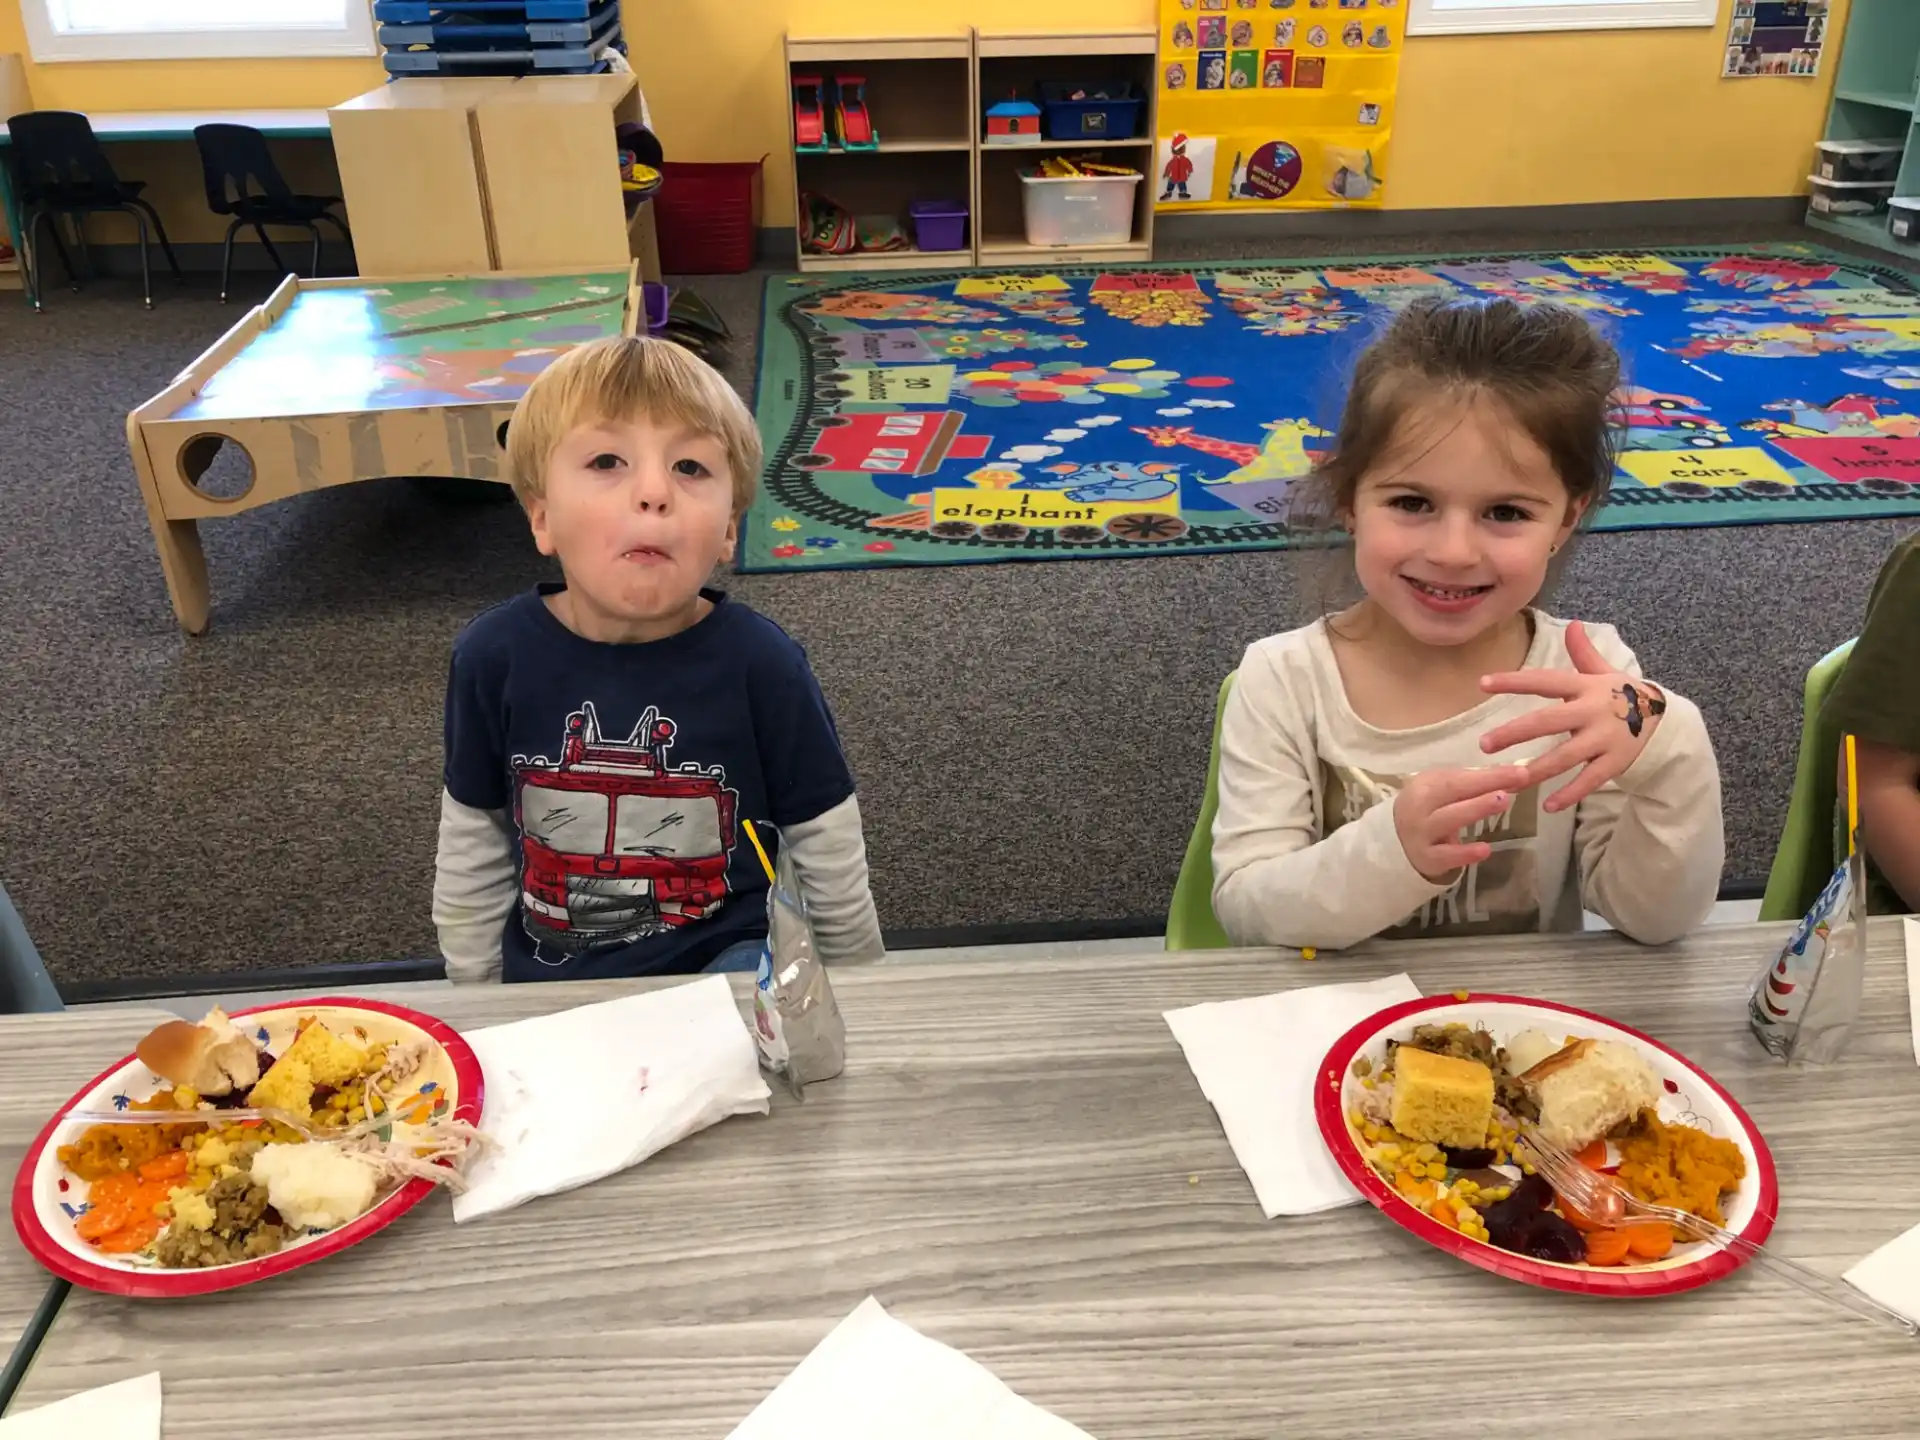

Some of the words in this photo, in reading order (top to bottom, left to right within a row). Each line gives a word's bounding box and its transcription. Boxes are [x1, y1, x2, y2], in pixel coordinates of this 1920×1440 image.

[984, 279, 1035, 287] hats
[867, 369, 897, 401] balloons
[904, 377, 932, 390] 20
[1861, 445, 1889, 457] 5
[1678, 455, 1704, 465] 4
[1670, 467, 1748, 477] cars
[1020, 493, 1030, 505] 1
[942, 503, 1099, 521] elephant
